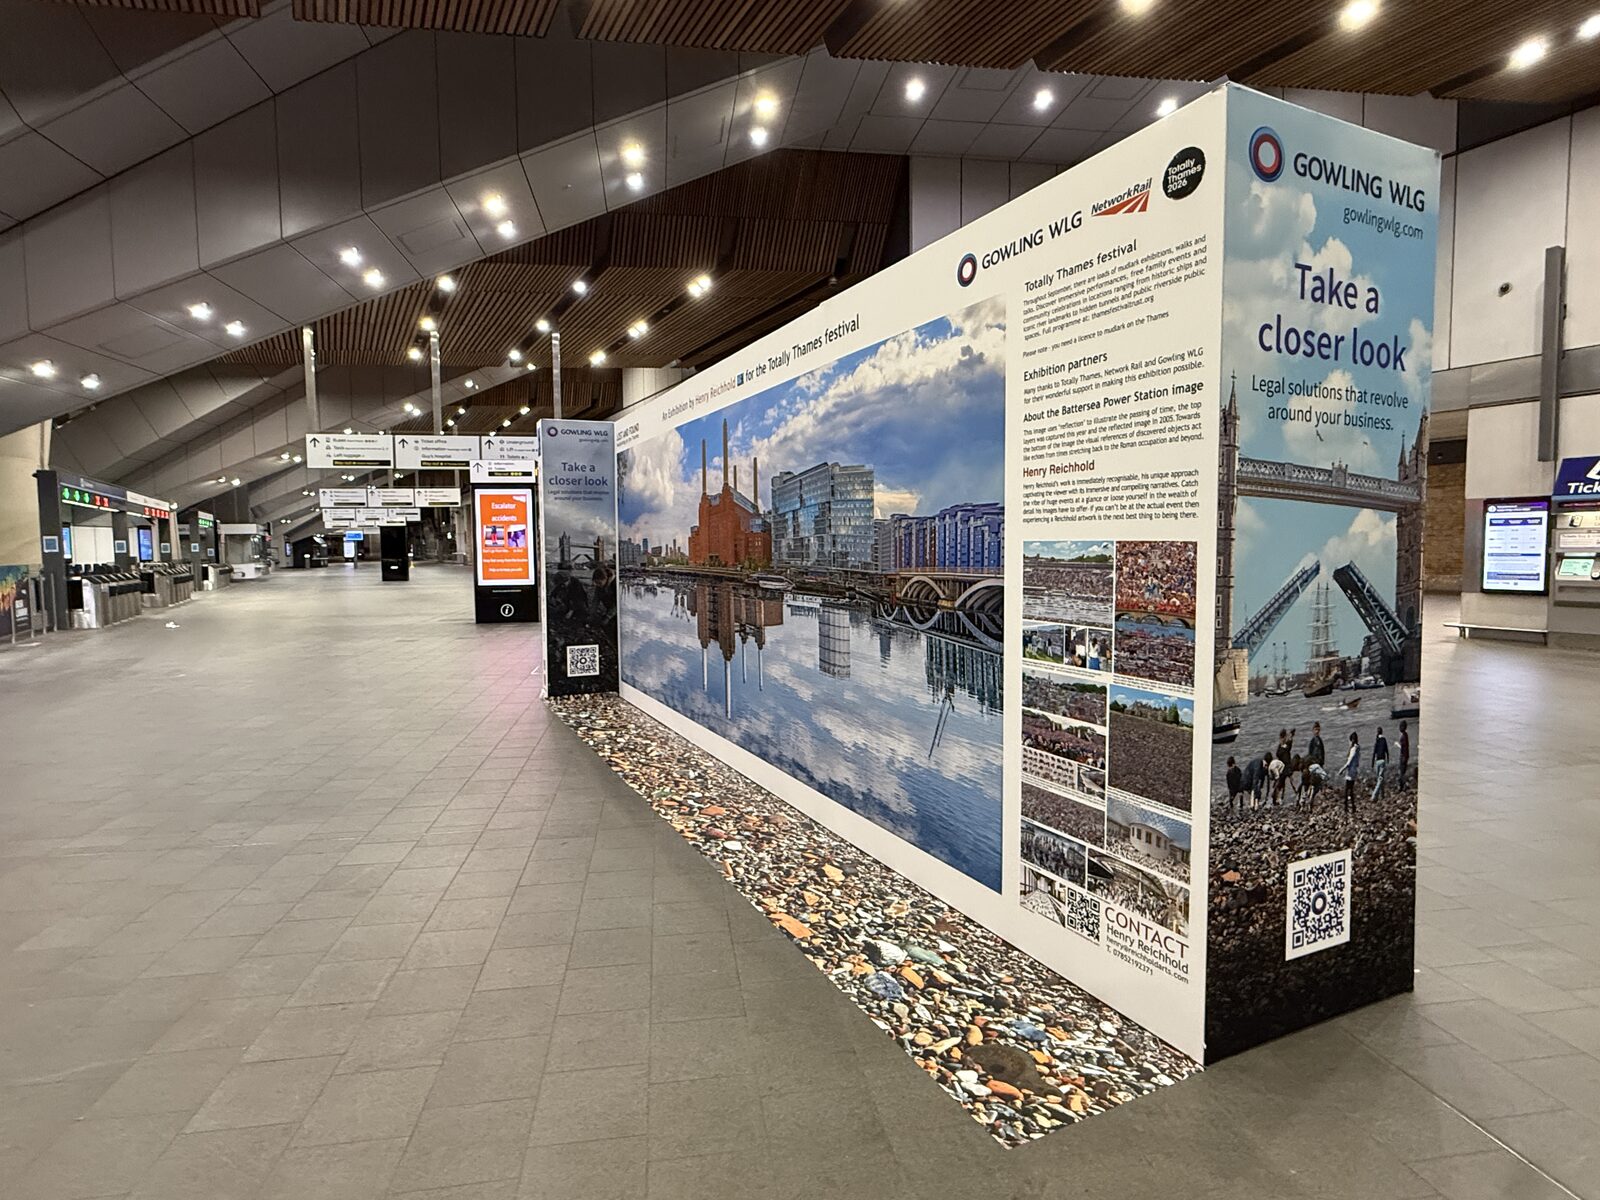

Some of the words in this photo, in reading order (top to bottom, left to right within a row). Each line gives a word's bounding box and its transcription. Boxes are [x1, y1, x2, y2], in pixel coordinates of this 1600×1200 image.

[1168, 158, 1195, 175] Totally
[1168, 164, 1202, 183] Thames
[1167, 179, 1188, 192] 2026
[1294, 153, 1382, 198] GOWLING
[1389, 180, 1425, 212] WLG
[1343, 207, 1424, 240] gowlingwlg.com
[982, 229, 1043, 270] GOWLING
[1049, 211, 1082, 239] WLG
[1175, 240, 1192, 250] walks
[1193, 234, 1206, 245] and
[1024, 274, 1054, 292] Totally
[1056, 259, 1093, 279] Thames
[1097, 239, 1136, 264] festival
[1113, 281, 1134, 292] ranging
[1135, 276, 1150, 285] from
[1151, 267, 1174, 280] historic
[1176, 261, 1192, 272] ships
[1194, 255, 1207, 266] and
[1130, 268, 1144, 277] free
[1145, 260, 1166, 272] family
[1167, 251, 1191, 264] events
[1192, 244, 1207, 256] and
[1120, 290, 1132, 300] and
[1133, 285, 1152, 298] public
[1153, 276, 1182, 289] riverside
[1183, 268, 1205, 282] public
[1294, 263, 1358, 310] Take
[1365, 286, 1379, 314] a
[1146, 311, 1169, 322] Thames
[746, 369, 755, 382] for
[756, 362, 766, 377] the
[768, 350, 790, 371] Totally
[792, 336, 822, 360] Thames
[825, 313, 860, 344] festival
[1258, 314, 1344, 361] closer
[1352, 328, 1407, 372] look
[1023, 364, 1065, 381] Exhibition
[1068, 352, 1107, 372] partners
[1079, 372, 1102, 381] Thames,
[1104, 364, 1129, 376] Network
[1130, 360, 1142, 370] Rail
[1144, 357, 1156, 367] and
[1157, 352, 1185, 364] Gowling
[1186, 346, 1203, 358] WLG
[1101, 377, 1123, 387] making
[1124, 374, 1136, 382] this
[1137, 367, 1171, 380] exhibition
[1172, 360, 1204, 374] possible.
[1023, 411, 1044, 422] About
[1046, 408, 1059, 418] the
[1061, 401, 1100, 415] Battersea
[1103, 395, 1131, 407] Power
[1134, 388, 1168, 401] Station
[1172, 382, 1203, 394] image
[1252, 375, 1284, 397] Legal
[1288, 379, 1342, 401] solutions
[1345, 386, 1368, 404] that
[1370, 392, 1409, 409] revolve
[1175, 411, 1200, 421] Towards
[1177, 403, 1188, 411] the
[1190, 401, 1202, 410] top
[1268, 406, 1312, 422] around
[1315, 411, 1342, 428] your
[1344, 410, 1394, 431] business.
[1137, 437, 1167, 446] occupation
[1168, 434, 1179, 443] and
[1180, 432, 1203, 442] beyond.
[549, 475, 582, 486] closer
[585, 476, 608, 486] look
[562, 462, 586, 472] Take
[1022, 467, 1047, 478] Henry
[1049, 460, 1094, 474] Reichhold
[1170, 469, 1198, 478] approach
[1125, 492, 1147, 501] yourself
[1167, 490, 1189, 498] wealth
[1190, 489, 1197, 497] of
[1180, 479, 1198, 487] Catch
[1138, 512, 1153, 520] thing
[1161, 511, 1178, 520] being
[1105, 906, 1189, 958] CONTACT
[1106, 944, 1112, 953] T.
[1106, 935, 1189, 984] henry@reichholdarts.com
[1107, 924, 1134, 947] Henry
[1138, 940, 1189, 975] Reichhold
